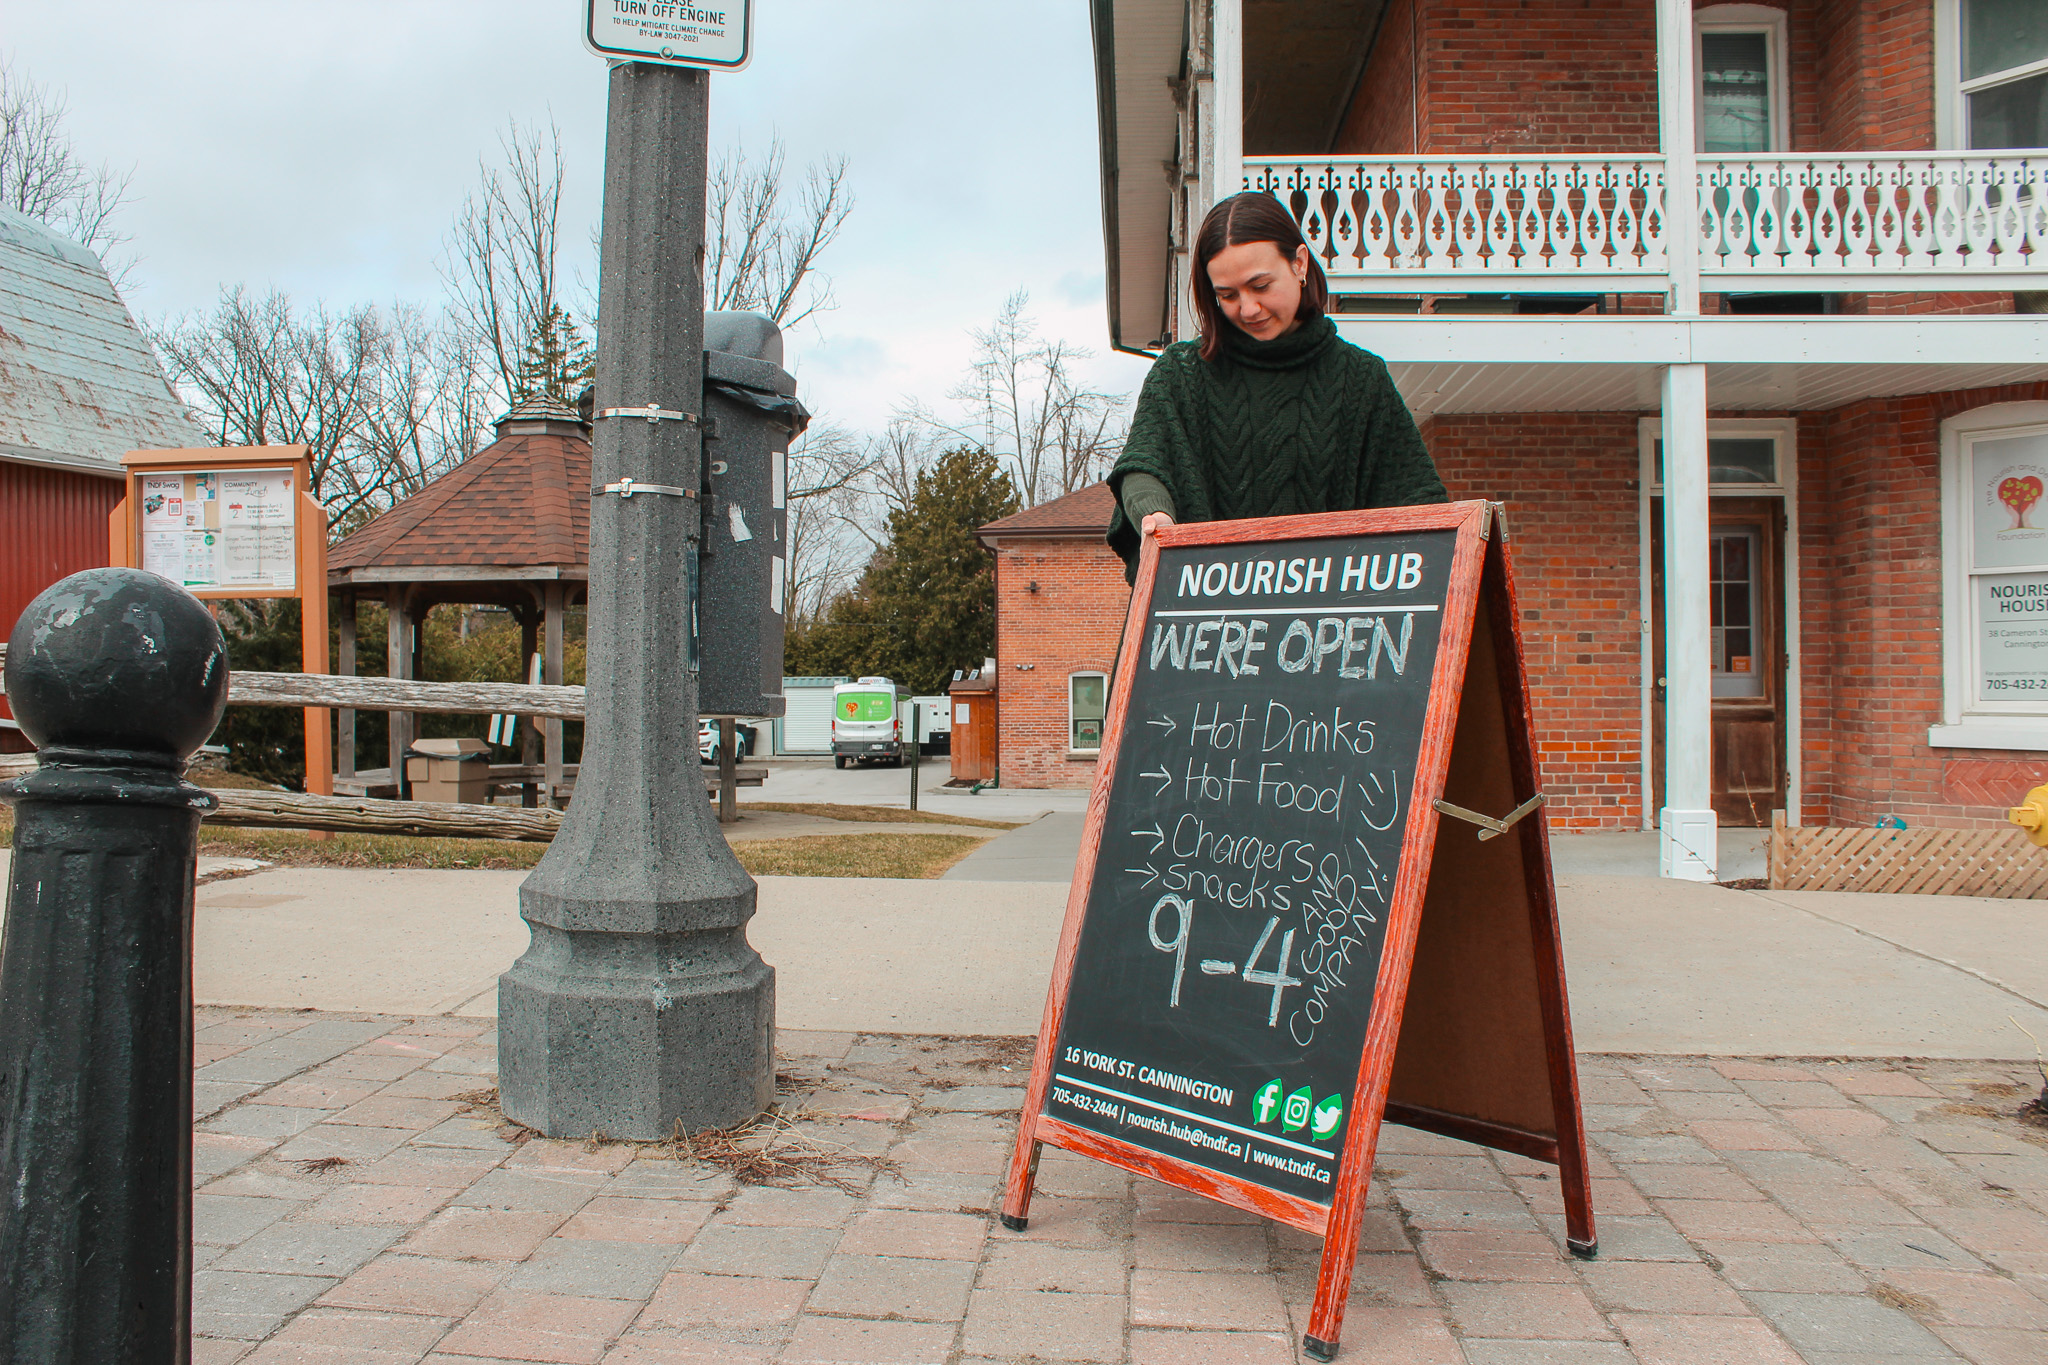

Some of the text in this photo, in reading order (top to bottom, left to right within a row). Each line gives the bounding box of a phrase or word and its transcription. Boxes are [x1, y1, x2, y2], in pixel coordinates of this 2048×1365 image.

[614, 0, 725, 25] TURN OFF ENGINE
[613, 17, 725, 37] TO HELP MITIGATE CLIMATE CHANGE
[639, 29, 699, 42] BY-LAW 3047-2021
[163, 481, 179, 490] Swag
[1987, 465, 2016, 488] Nourish
[2017, 464, 2037, 472] and
[245, 485, 268, 498] Lunch
[232, 509, 239, 519] 2
[1997, 532, 2046, 541] Foundation
[1177, 552, 1423, 597] NOURISH HUB
[2000, 599, 2048, 613] HOUS
[1988, 627, 2048, 638] 38 Cameron St
[1277, 613, 1414, 680] OPEN
[1986, 679, 2048, 690] 705-432-2
[1190, 698, 1376, 755] Hot Drinks
[1184, 756, 1345, 822] Hot Food
[1172, 813, 1315, 885] Chargers
[1162, 863, 1291, 910] Snacks
[1303, 852, 1339, 934] AND
[1301, 874, 1356, 974] GOOD
[1064, 1045, 1234, 1107] 16 YORK ST. CANNINGTON
[1052, 1086, 1118, 1119] 705-432-2444
[1127, 1111, 1242, 1159] nourish.hub@tndf.ca
[1253, 1150, 1331, 1185] www.tndf.ca
